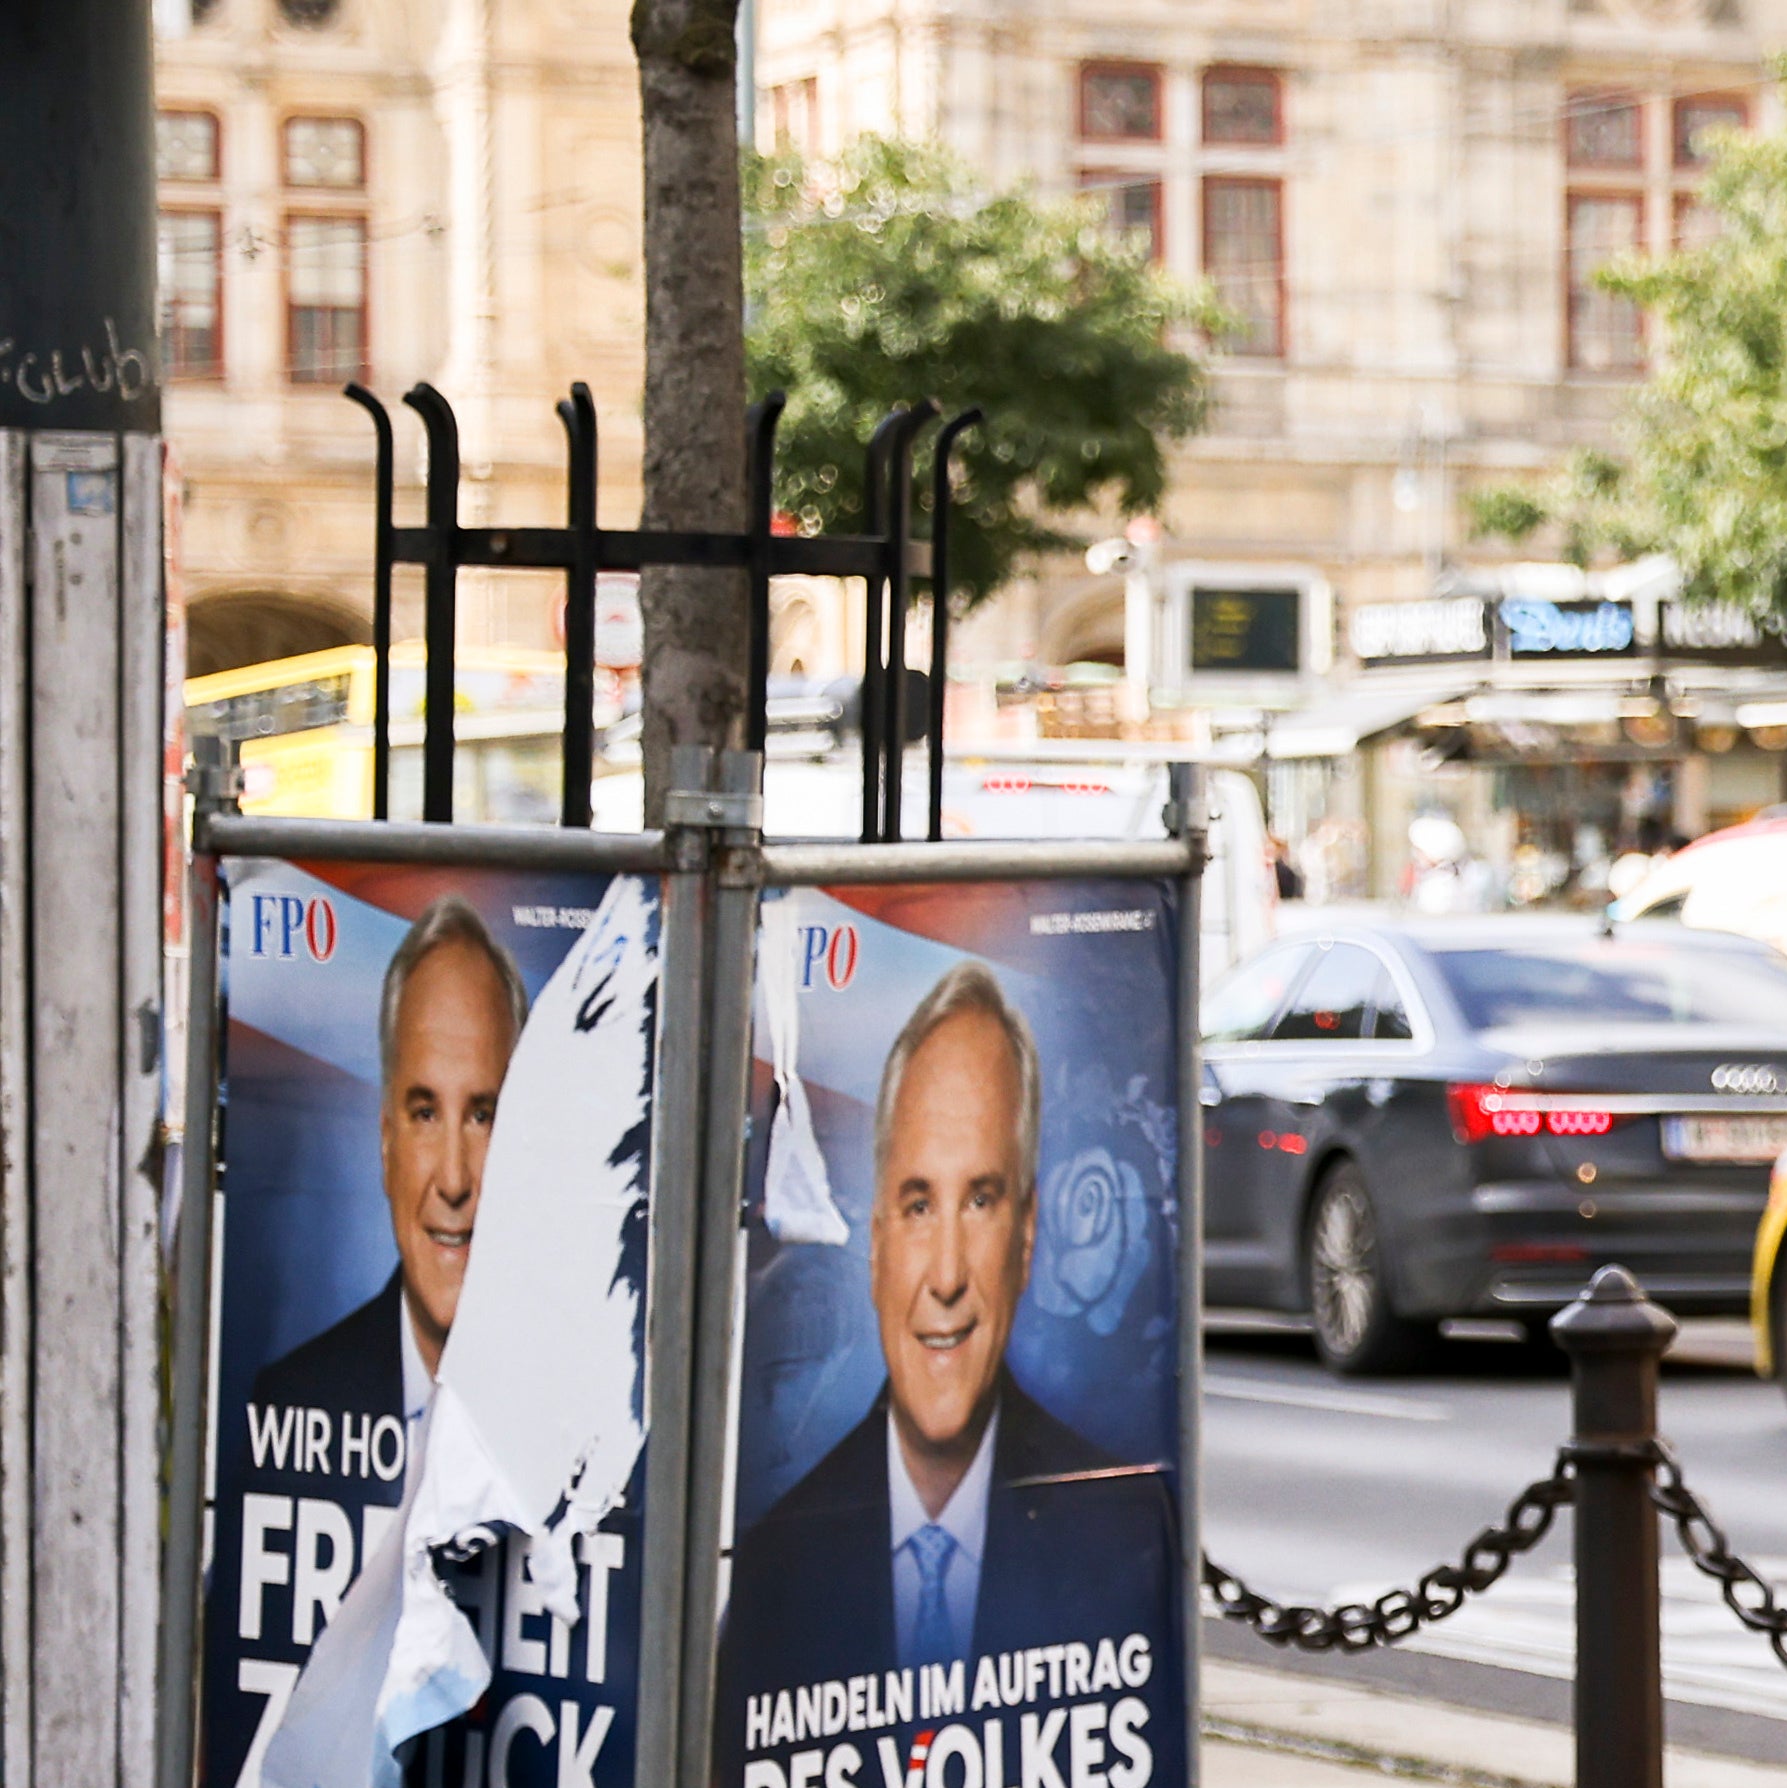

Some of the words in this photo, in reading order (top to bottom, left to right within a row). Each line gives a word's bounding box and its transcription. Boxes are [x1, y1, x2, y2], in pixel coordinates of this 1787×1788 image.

[246, 1403, 331, 1474] WIR
[745, 1667, 913, 1751] HANDELN
[920, 1659, 965, 1720] IM
[971, 1632, 1152, 1712] AUFTRAG
